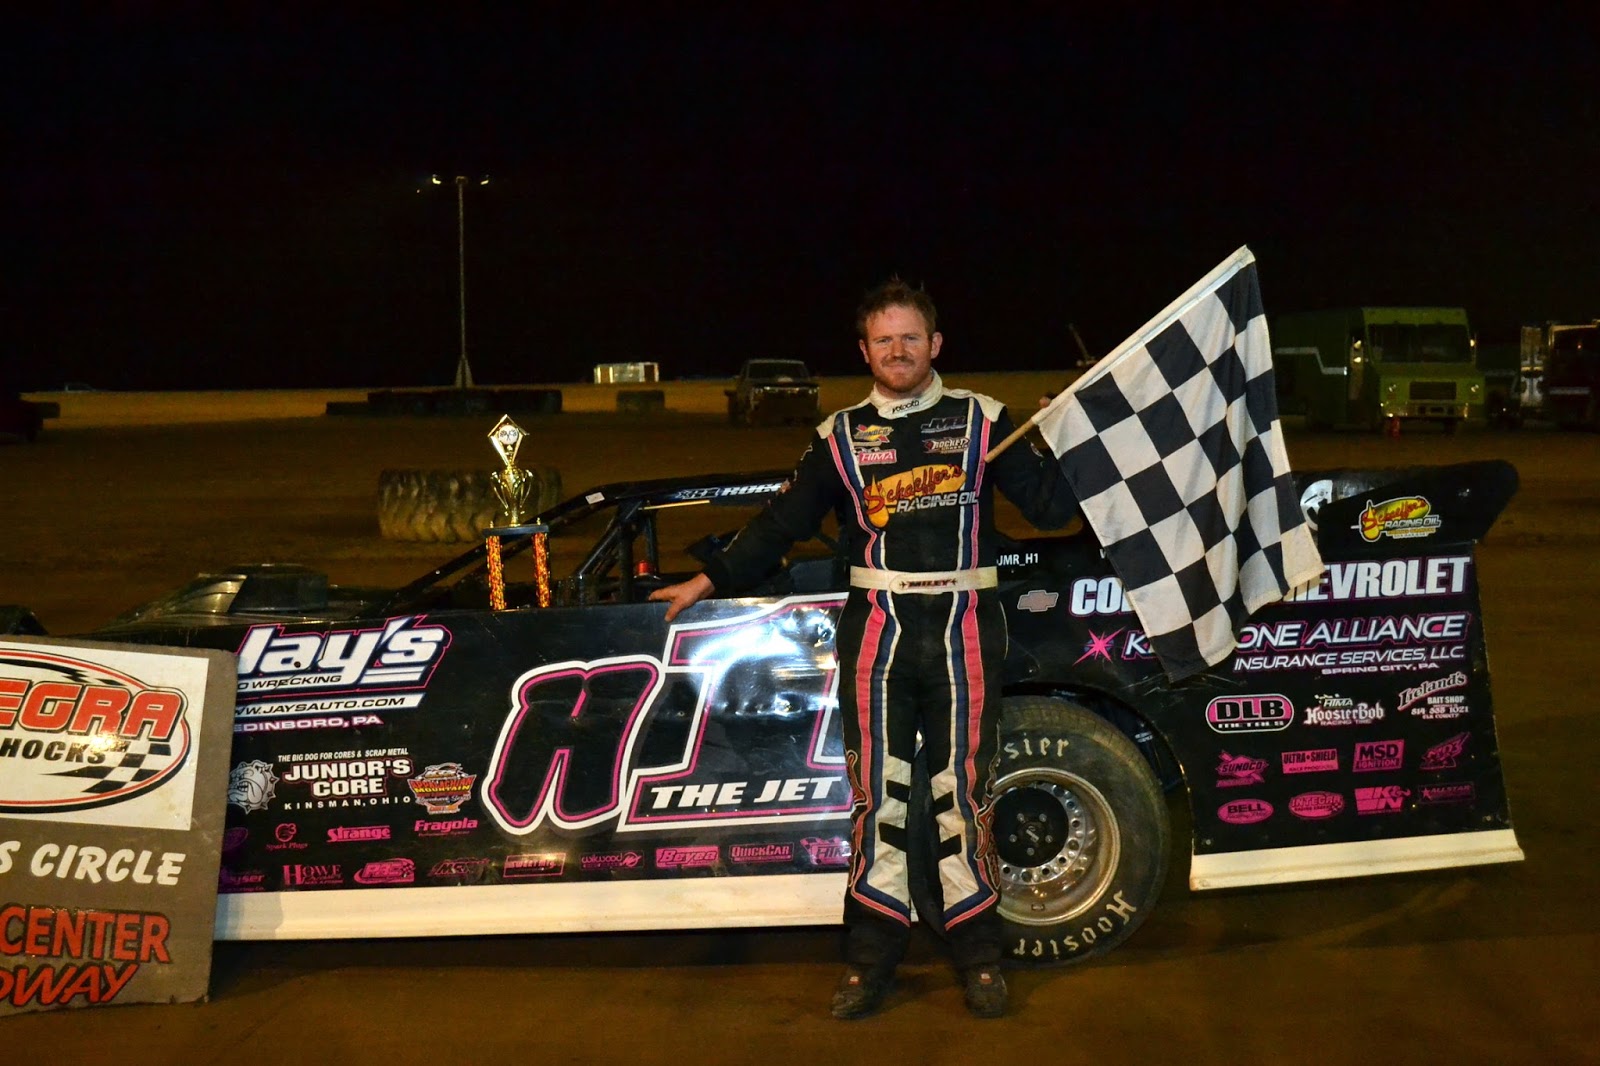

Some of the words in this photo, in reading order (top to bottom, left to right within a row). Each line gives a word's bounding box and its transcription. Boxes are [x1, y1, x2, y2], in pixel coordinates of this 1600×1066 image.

[896, 493, 958, 513] RACING
[958, 491, 979, 505] OIL
[1305, 614, 1466, 645] ALLIANCE
[1233, 651, 1338, 671] INSURANCE
[1339, 647, 1427, 665] SERVICES,
[1430, 645, 1465, 660] LLC.
[1321, 665, 1376, 676] SPRING
[1419, 662, 1440, 670] PA
[252, 675, 342, 689] WRECKING
[1427, 696, 1445, 705] BAIT
[1445, 695, 1465, 704] SHOP
[1215, 699, 1286, 721] DLB
[352, 715, 383, 726] PA
[1003, 733, 1070, 759] sier
[1359, 744, 1399, 760] MSD
[278, 754, 291, 762] THE
[292, 753, 303, 762] BIG
[304, 752, 319, 761] DOG
[320, 752, 332, 760] FOR
[333, 750, 356, 760] CORES
[365, 749, 389, 758] SCRAP
[390, 747, 409, 756] METAL
[285, 758, 411, 782] JUNIOR'S
[1221, 761, 1263, 773] SUNOCO
[1357, 758, 1398, 769] IGNITION
[313, 778, 384, 797] CORE
[651, 781, 746, 810] THE
[754, 776, 842, 803] JET
[370, 796, 411, 806] OHIO
[1228, 803, 1266, 814] BELL
[327, 825, 391, 841] Strange
[414, 817, 478, 833] Fragola
[30, 843, 187, 886] CIRCLE
[1013, 889, 1137, 960] Hoosier
[0, 903, 171, 964] CENTER
